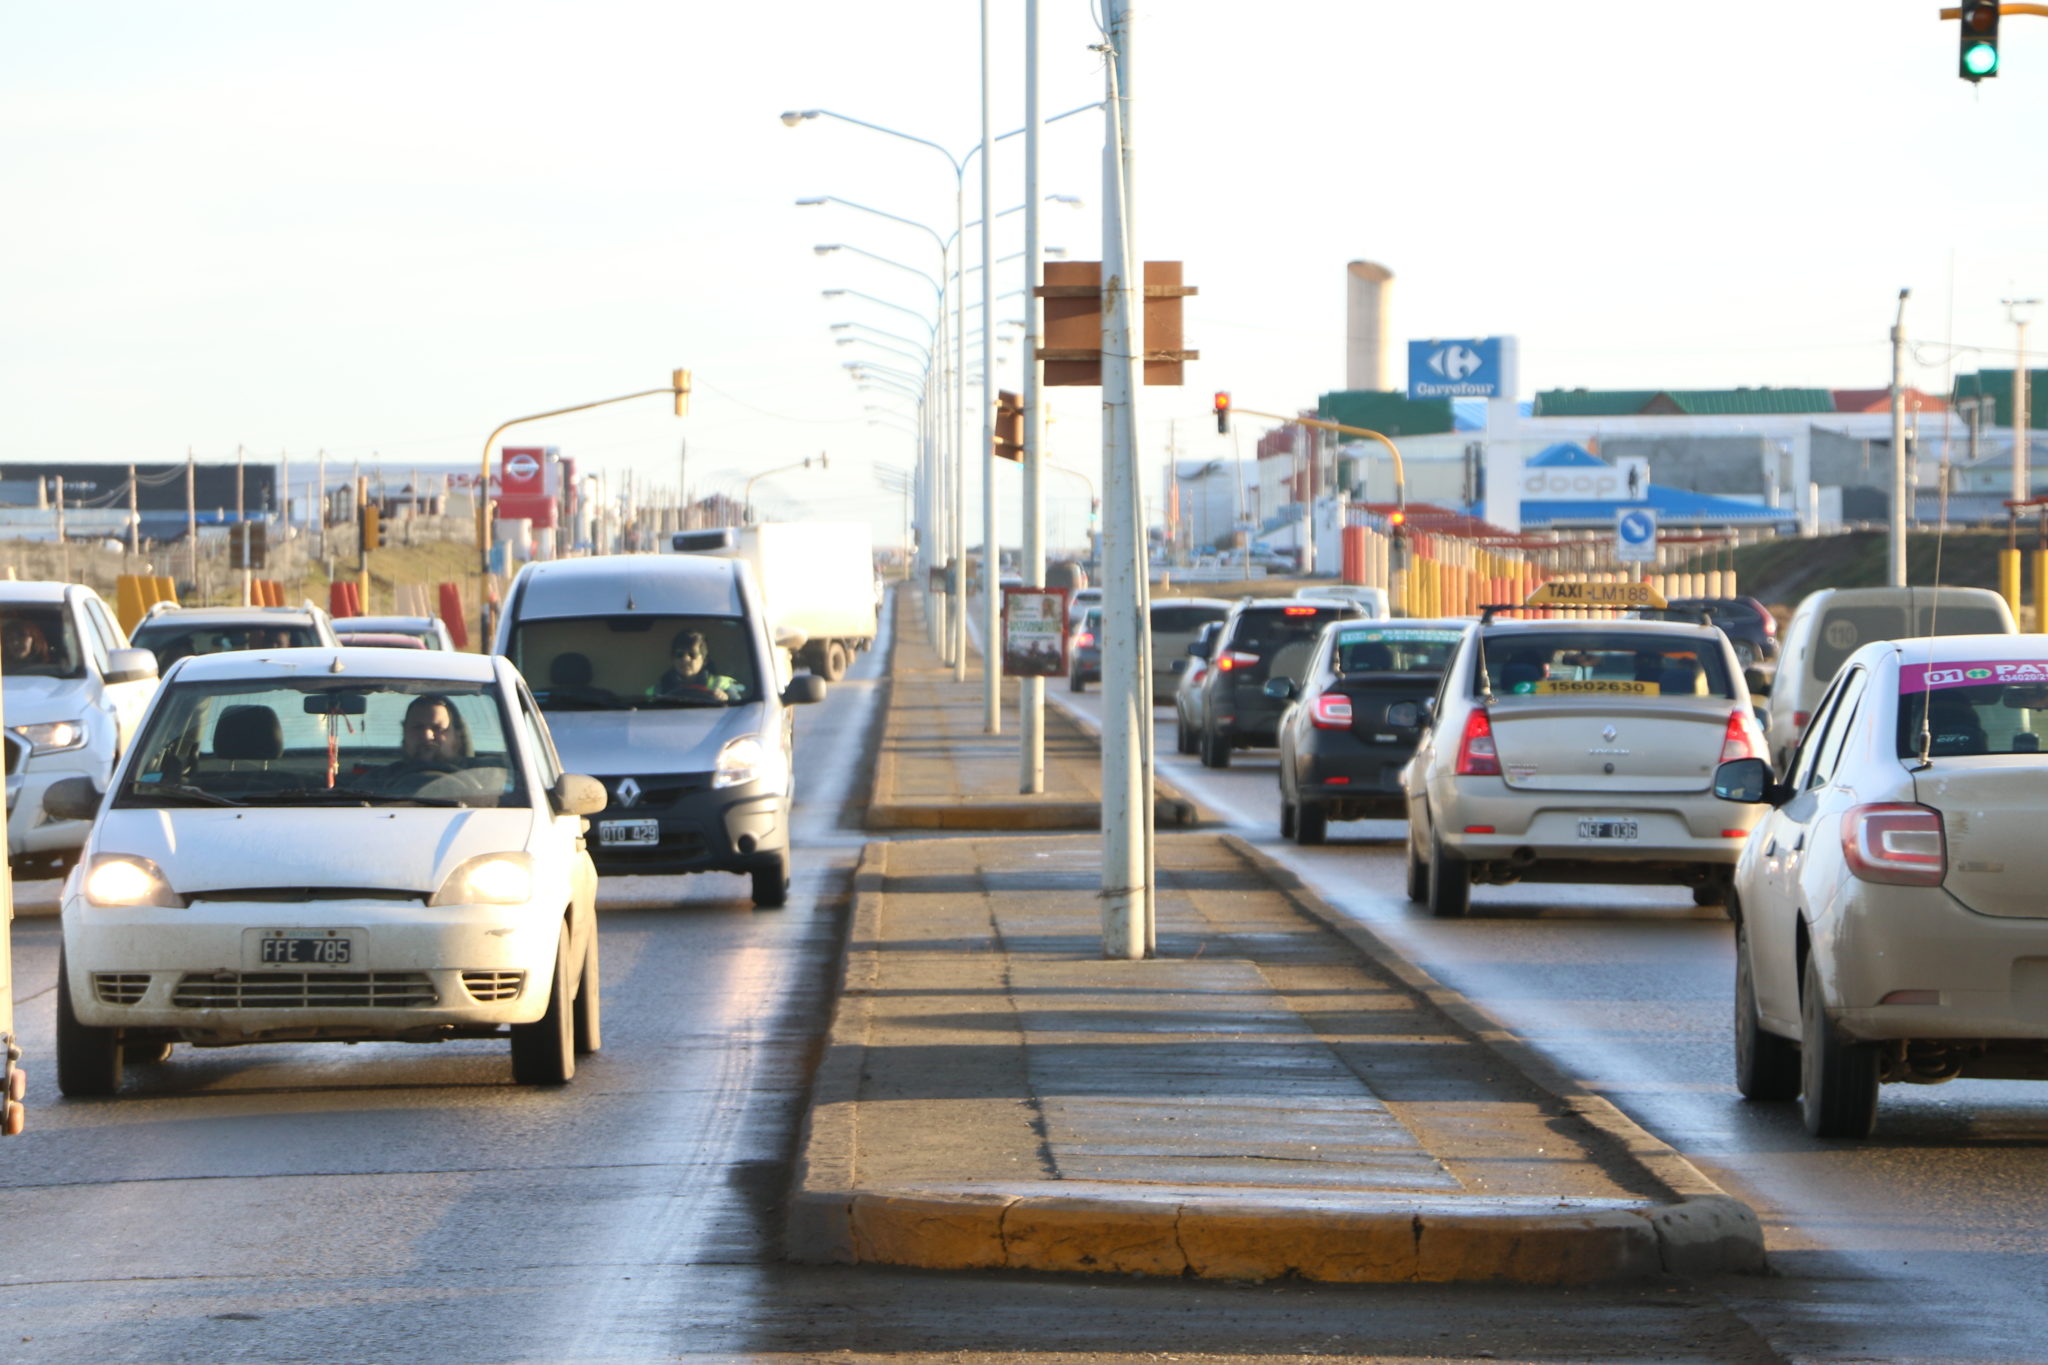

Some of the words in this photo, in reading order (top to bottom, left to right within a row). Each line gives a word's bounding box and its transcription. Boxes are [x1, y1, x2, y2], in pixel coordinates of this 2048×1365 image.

[1417, 382, 1495, 395] Carrefour
[1525, 472, 1617, 498] doop
[1548, 584, 1582, 598] TAXI
[1929, 671, 1960, 683] 01
[1550, 682, 1645, 693] 15602630
[602, 827, 626, 841] OTO
[633, 826, 657, 840] 429
[1580, 823, 1604, 838] NEF
[1611, 823, 1638, 839] 036
[263, 940, 299, 962] FFE
[313, 940, 349, 962] 785
